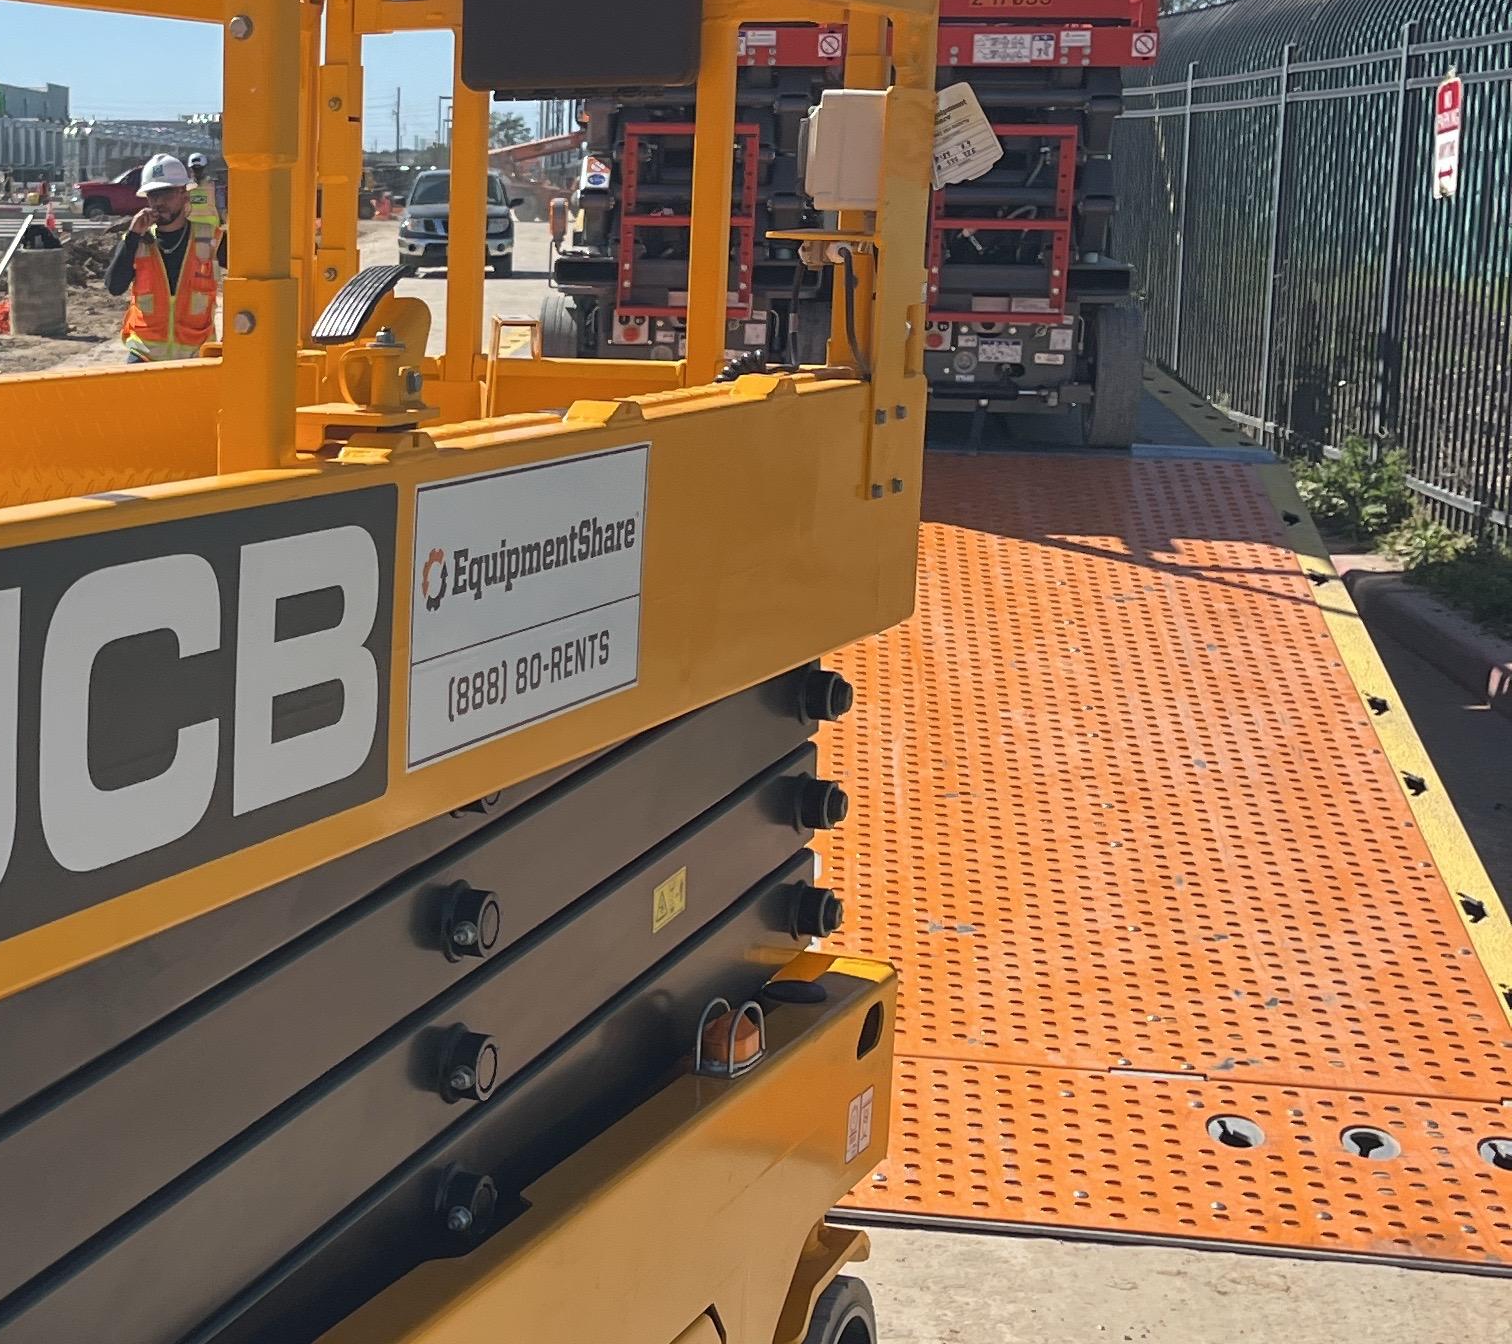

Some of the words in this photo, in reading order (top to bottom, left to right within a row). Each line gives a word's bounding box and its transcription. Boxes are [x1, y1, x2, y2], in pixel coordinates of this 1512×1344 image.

[451, 516, 636, 601] EquipmentShare
[448, 660, 507, 722] (888)
[515, 629, 610, 695] 80-RENTS
